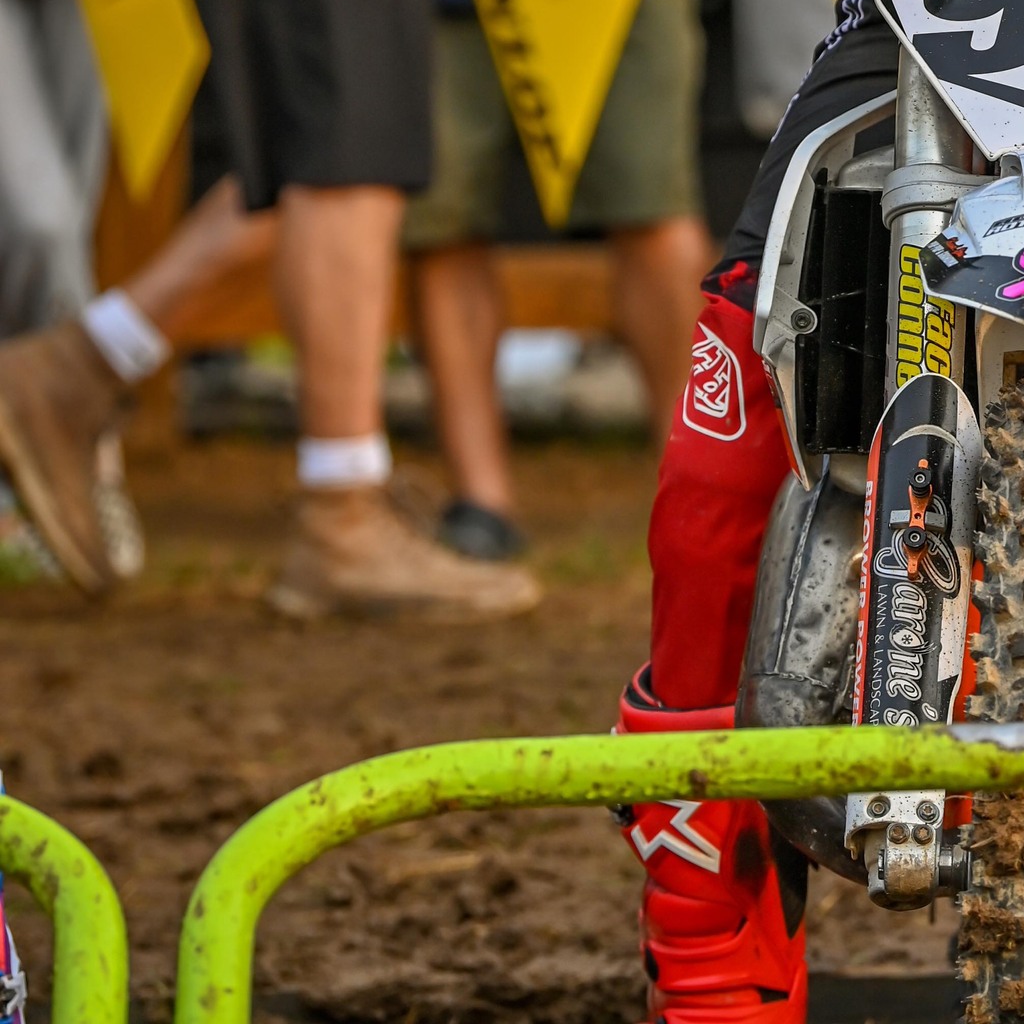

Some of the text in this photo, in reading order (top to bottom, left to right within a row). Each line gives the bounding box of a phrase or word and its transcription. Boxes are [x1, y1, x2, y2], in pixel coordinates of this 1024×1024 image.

[869, 584, 888, 726] LAWN & LANDSCAP
